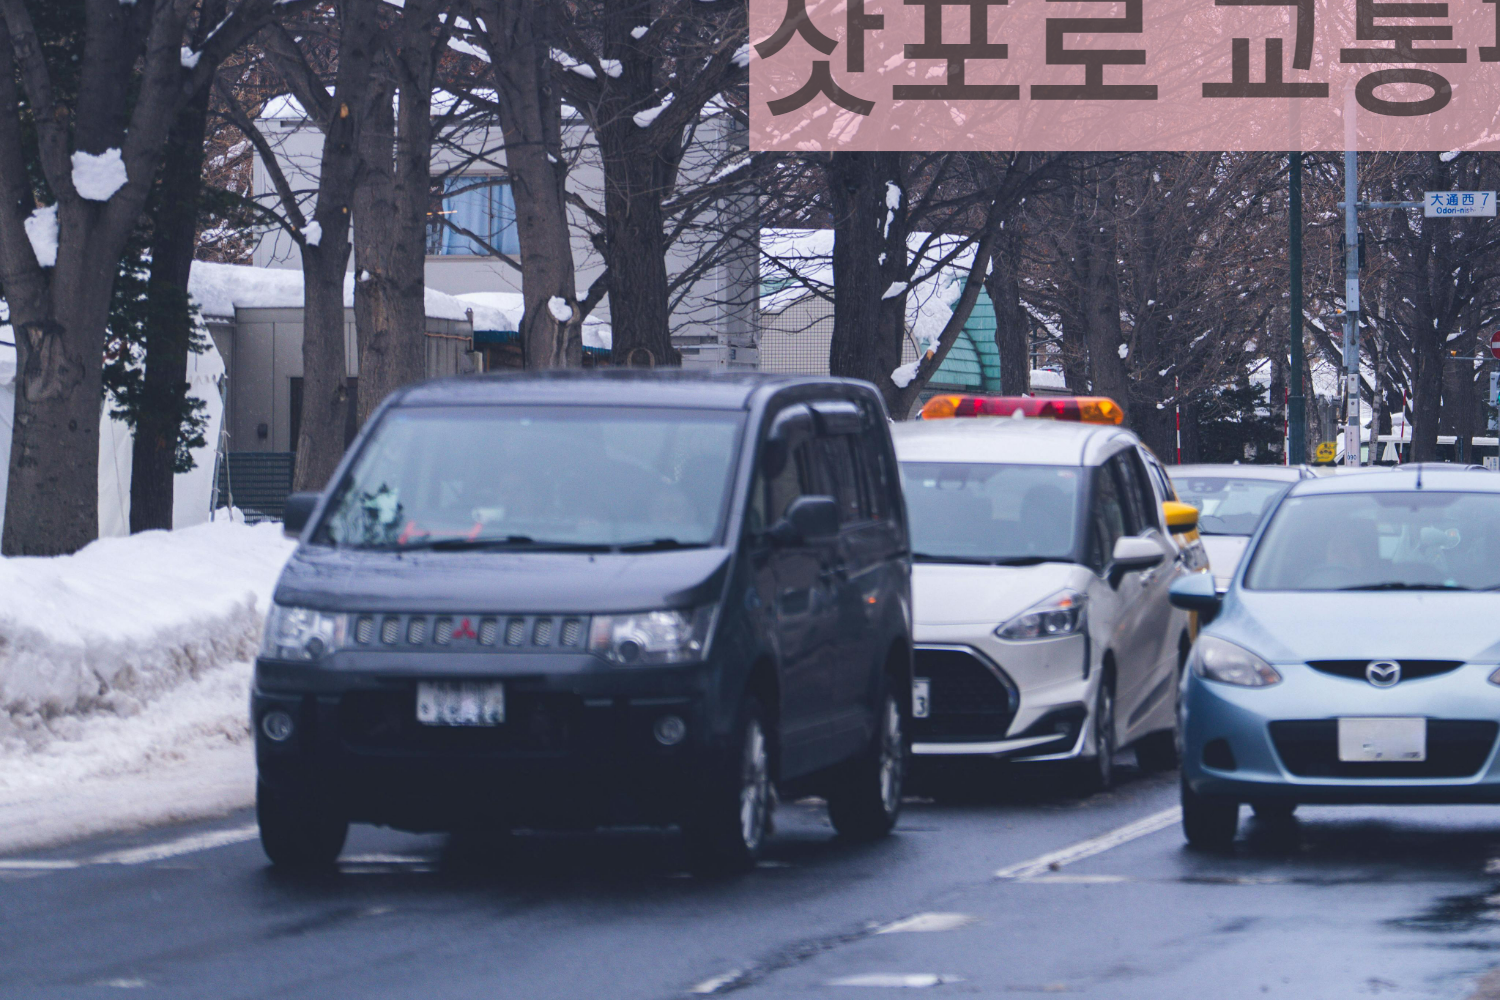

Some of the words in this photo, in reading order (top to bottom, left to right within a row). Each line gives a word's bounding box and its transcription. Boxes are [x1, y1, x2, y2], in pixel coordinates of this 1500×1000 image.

[1431, 193, 1475, 206] 大通西
[1481, 192, 1489, 206] 7
